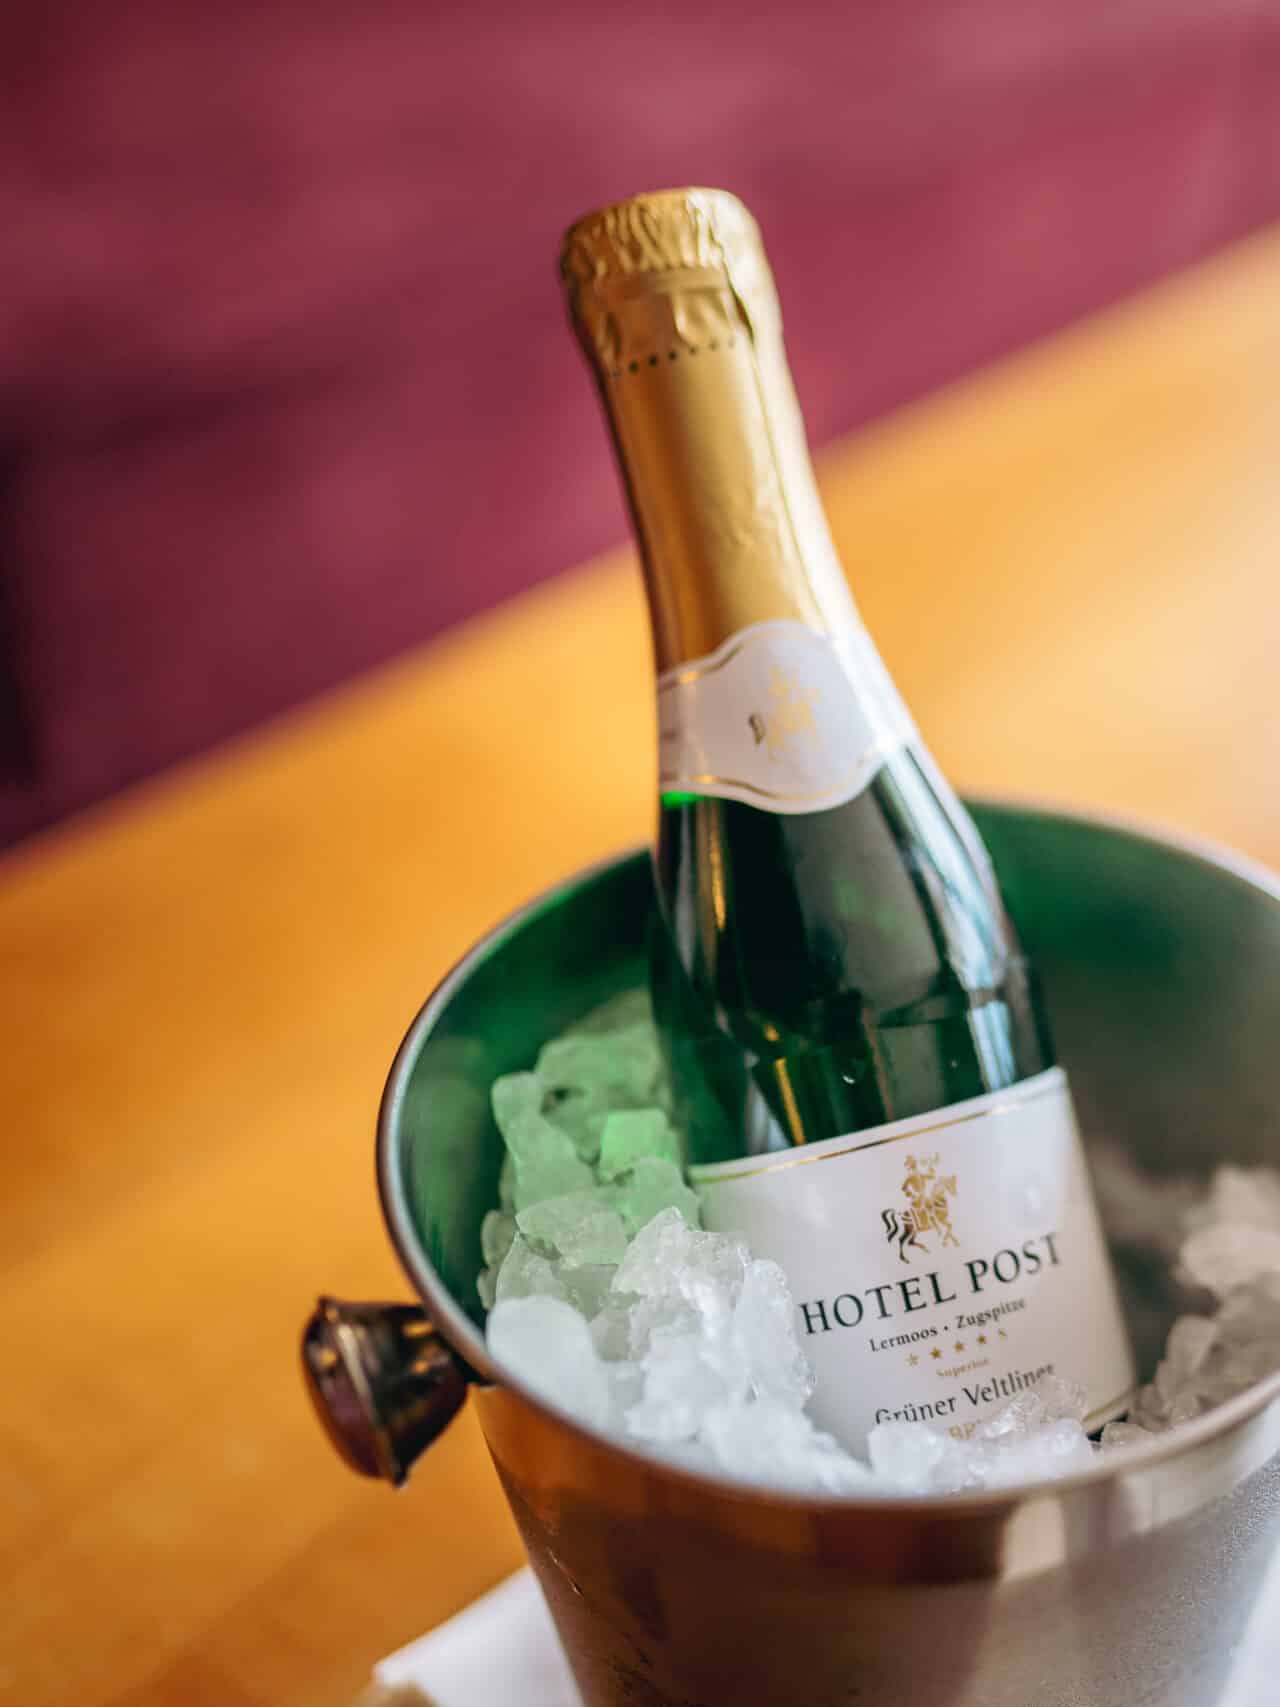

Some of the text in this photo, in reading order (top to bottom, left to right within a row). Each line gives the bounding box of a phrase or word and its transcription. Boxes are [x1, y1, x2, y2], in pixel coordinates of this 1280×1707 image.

[800, 1232, 1060, 1335] HOTEL POST
[869, 1299, 1026, 1352] Lermoos Zugspitze
